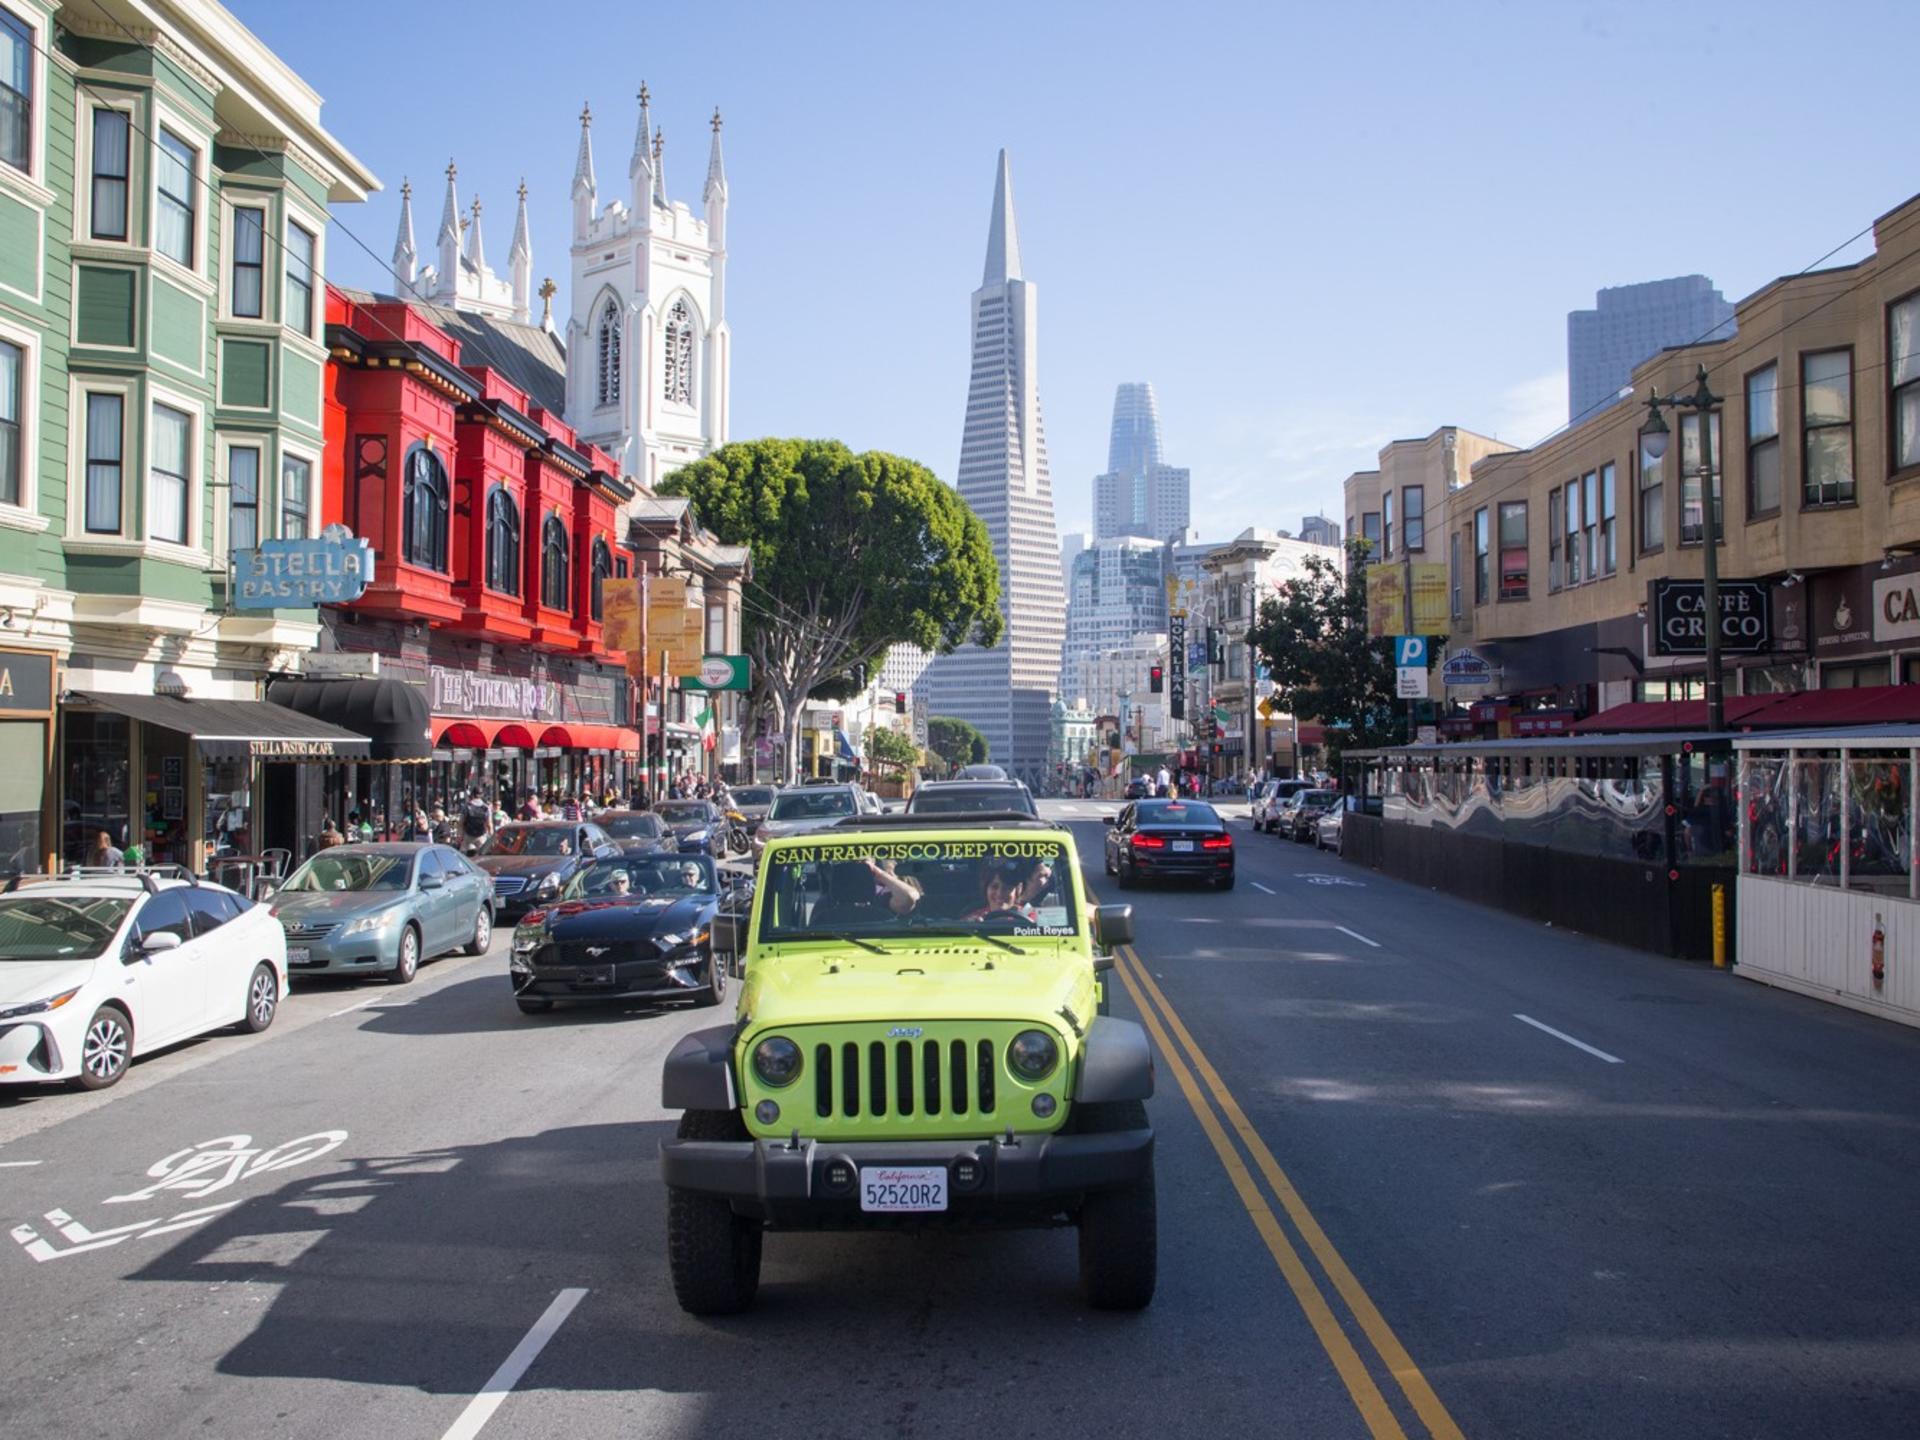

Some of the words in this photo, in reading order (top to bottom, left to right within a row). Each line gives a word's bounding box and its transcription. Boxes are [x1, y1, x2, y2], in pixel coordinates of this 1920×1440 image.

[251, 552, 360, 577] STELLA
[243, 580, 343, 598] PASTRY
[1172, 617, 1183, 651] MONA
[1667, 617, 1760, 637] GRCO
[430, 665, 461, 710] THE
[463, 670, 520, 712] STINKING
[250, 741, 280, 754] STELLA
[775, 848, 815, 865] SAN
[821, 844, 940, 862] FRANCISCO
[944, 843, 988, 859] JEEP
[991, 843, 1060, 858] TOURS
[1013, 926, 1040, 936] Point
[1044, 926, 1074, 936] Reyes
[887, 1026, 922, 1039] Jeep
[878, 1170, 926, 1183] California
[867, 1184, 941, 1205] 52520R2
